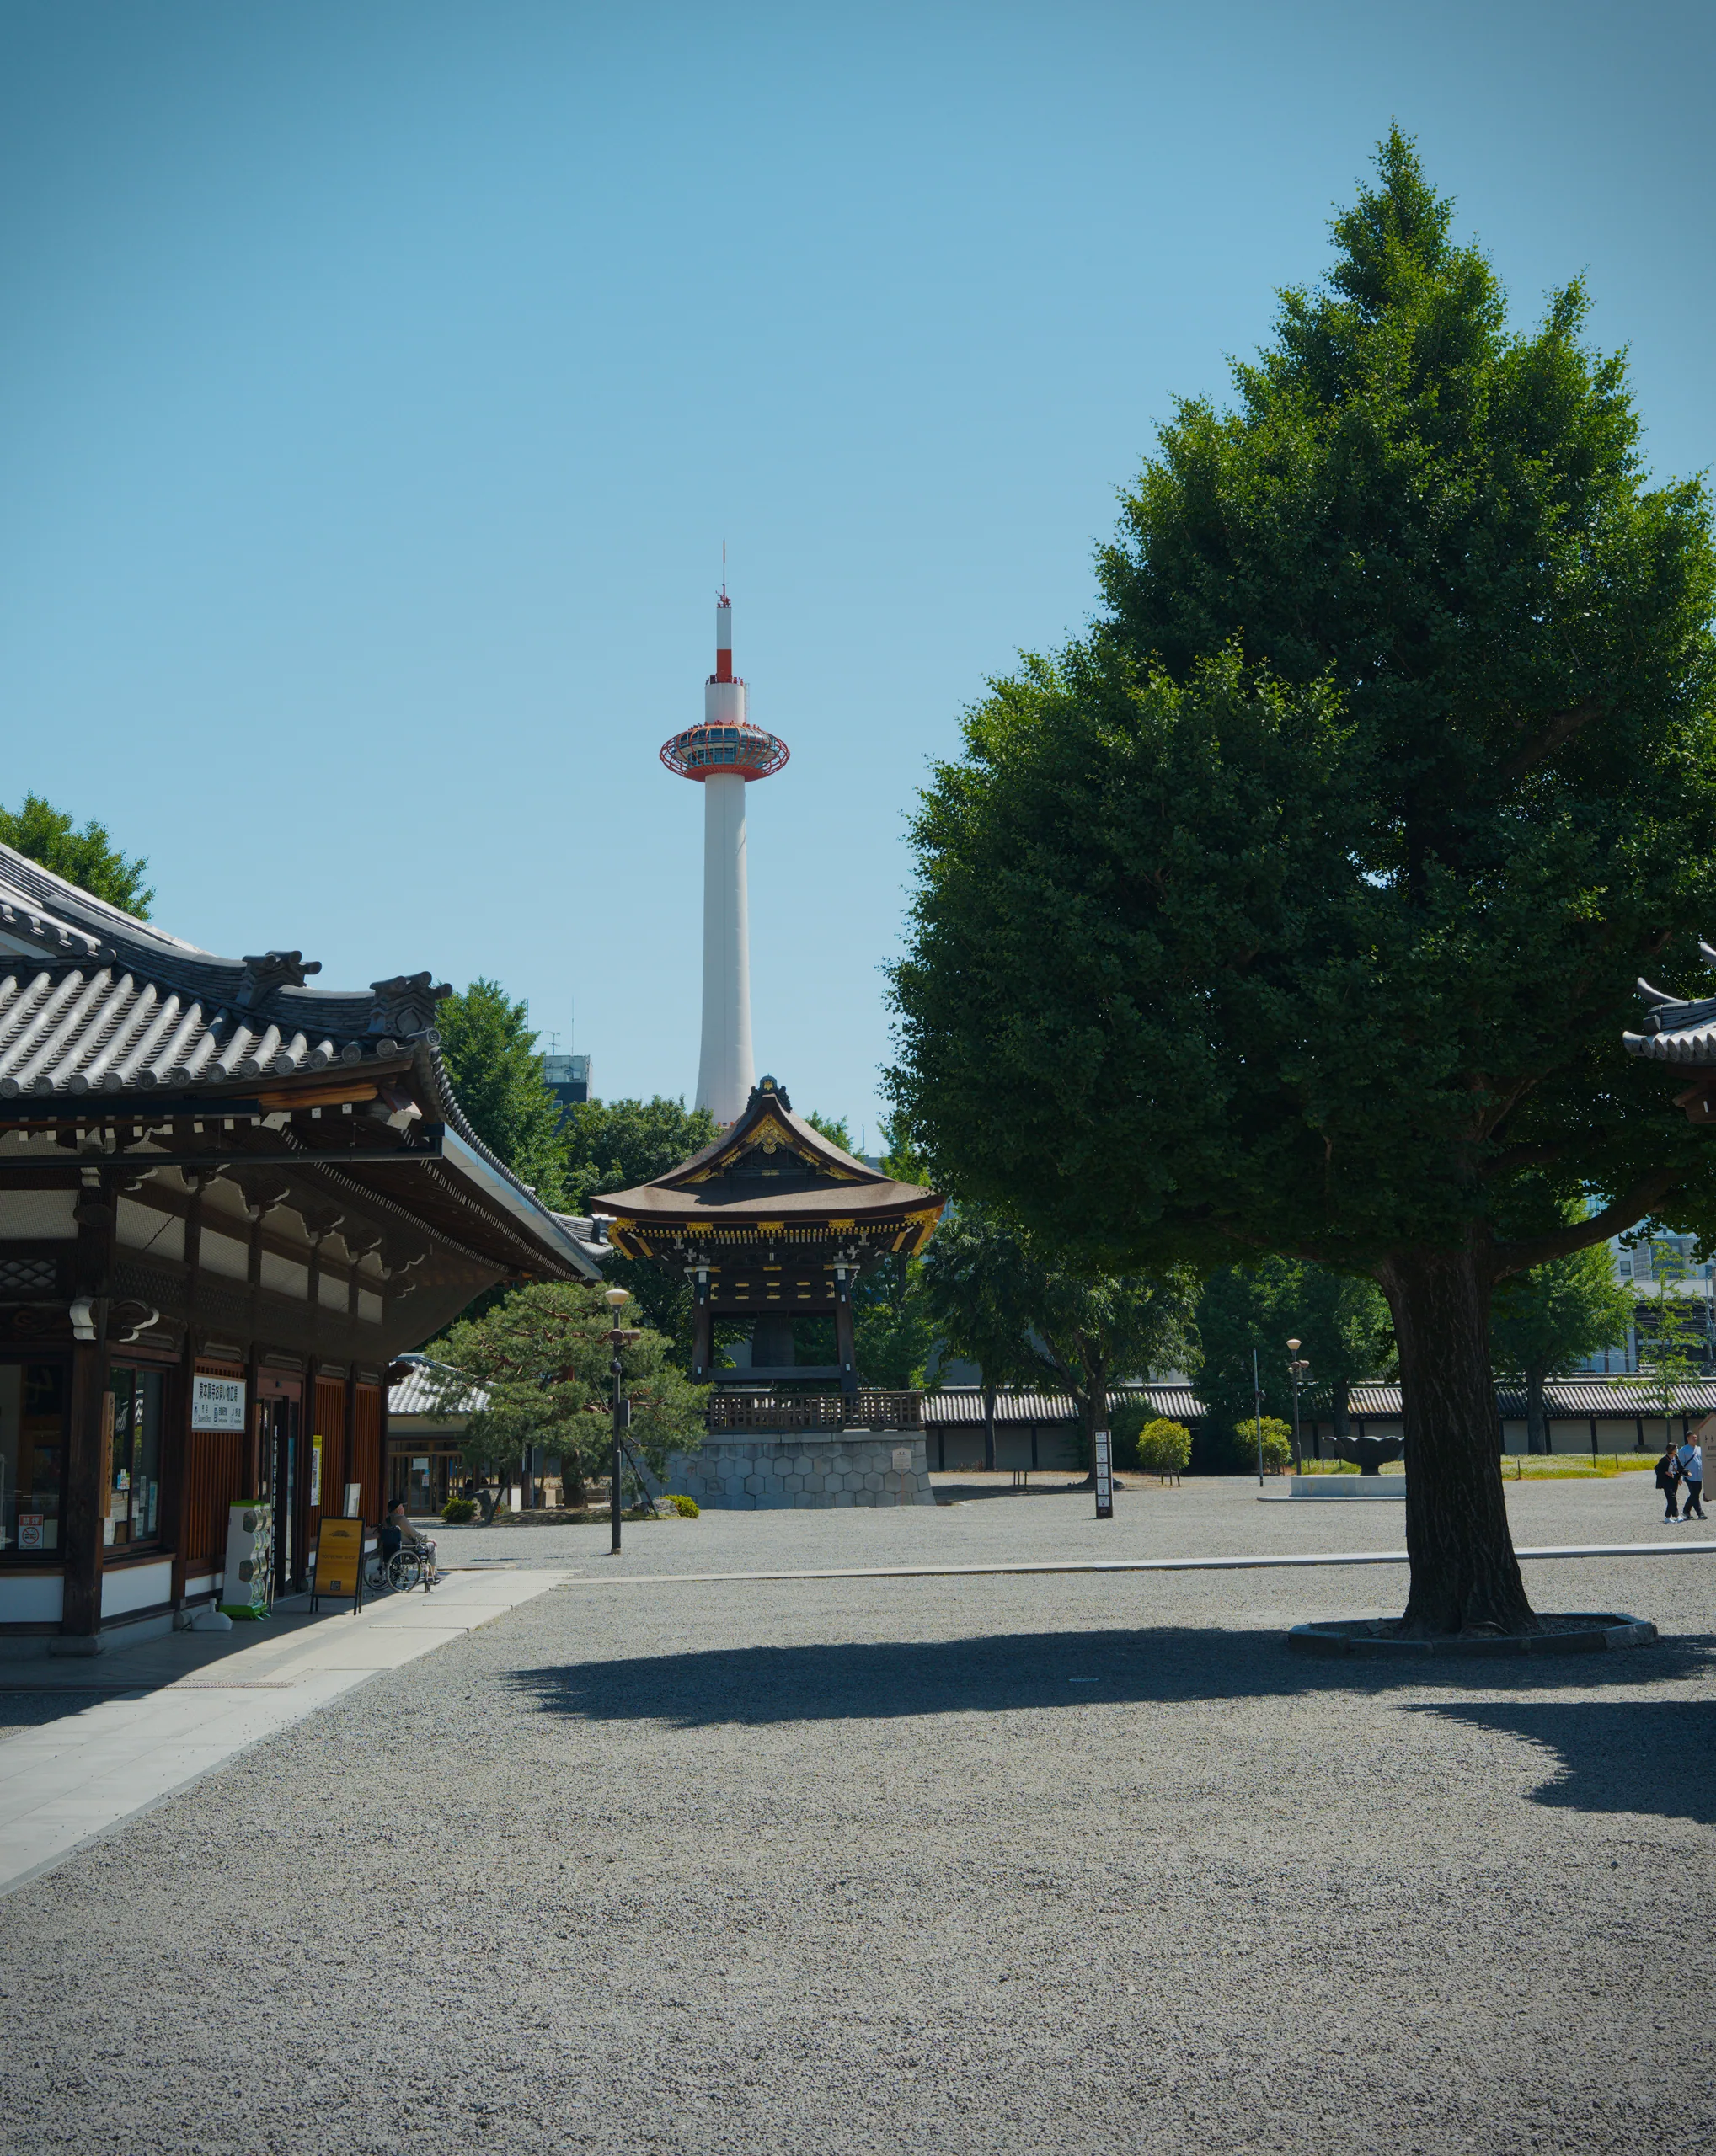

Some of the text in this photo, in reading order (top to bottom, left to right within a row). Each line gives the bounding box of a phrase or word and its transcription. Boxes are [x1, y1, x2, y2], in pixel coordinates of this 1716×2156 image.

[199, 1382, 238, 1402] 東本願寺お買い物広場
[23, 1517, 40, 1525] 禁煙
